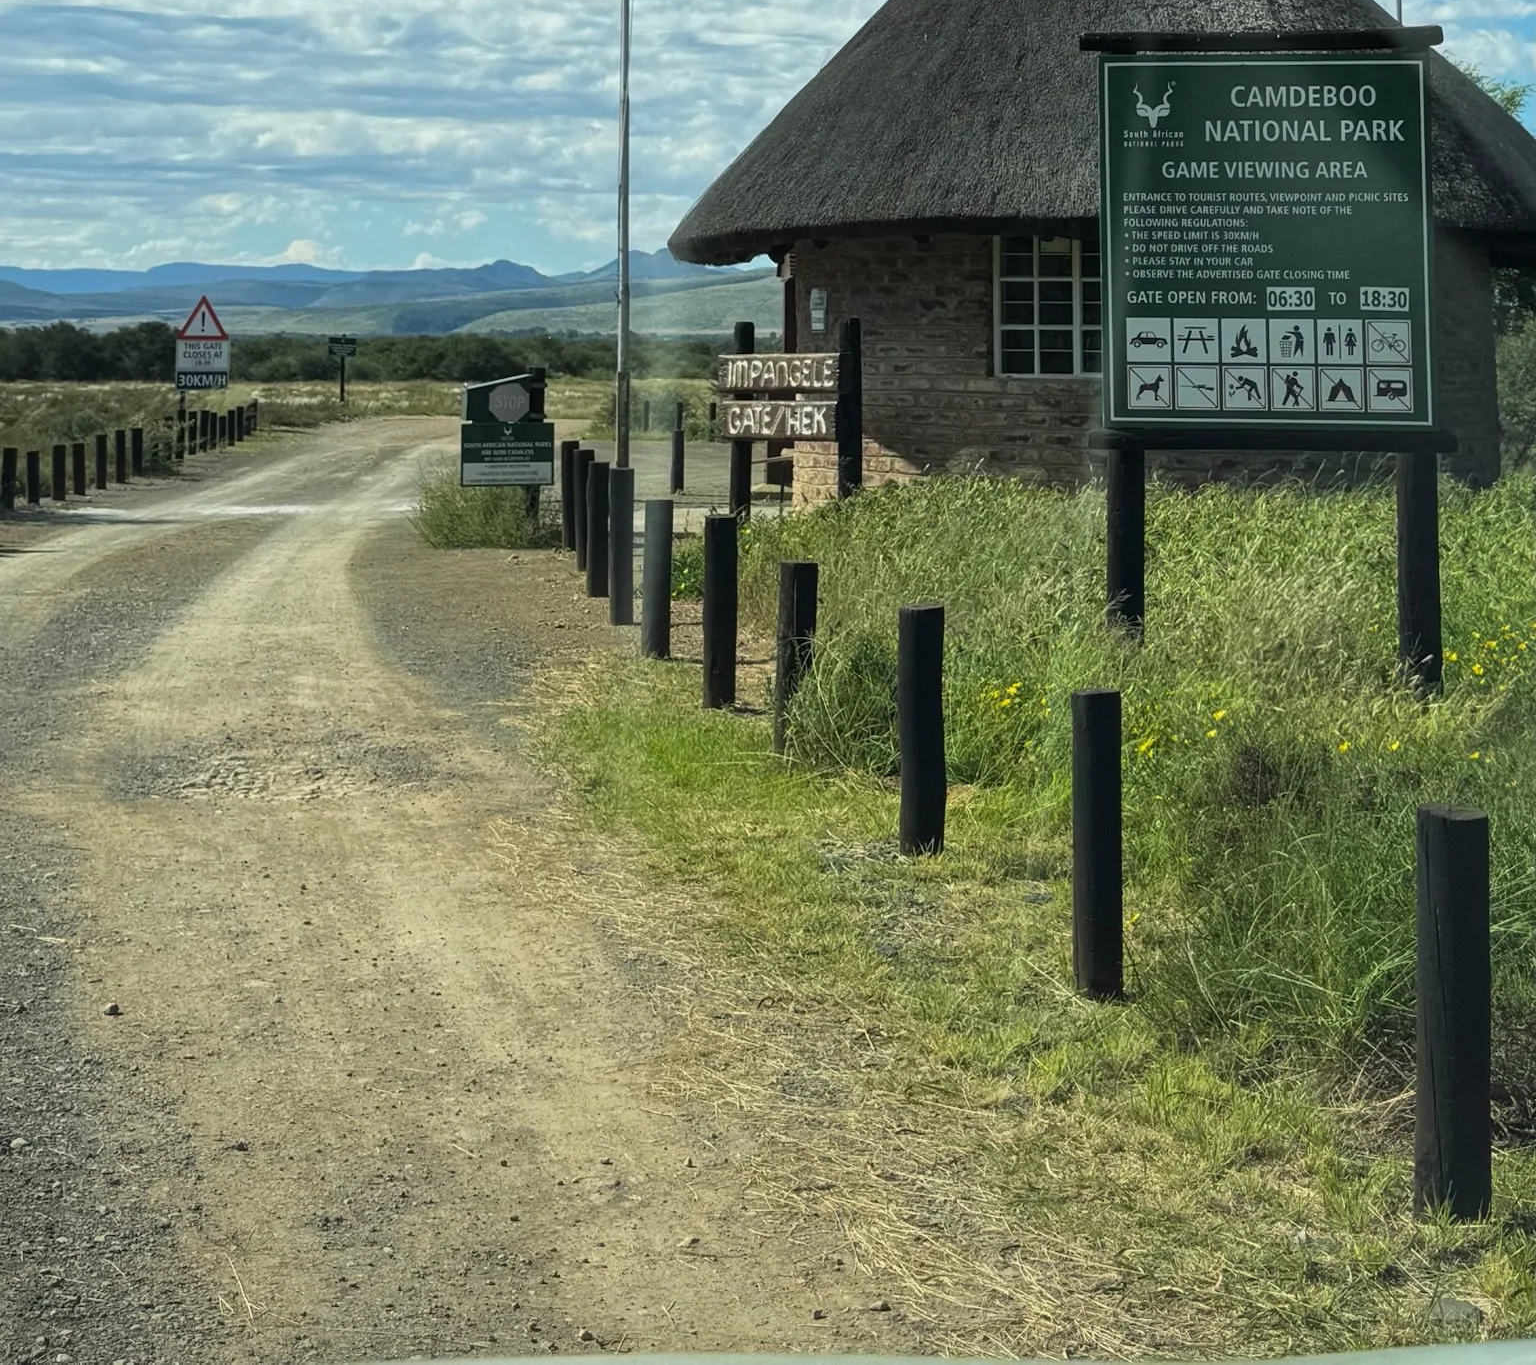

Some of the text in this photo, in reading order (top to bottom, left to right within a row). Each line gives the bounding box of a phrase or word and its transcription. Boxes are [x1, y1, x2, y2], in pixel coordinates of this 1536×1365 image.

[1230, 85, 1377, 107] CAMDEBOO
[1123, 130, 1184, 138] South African
[1205, 120, 1405, 142] NATIONAL PARK
[1162, 161, 1367, 178] GAME VIEWING AREA
[1123, 193, 1408, 203] ENTRANCE TO TOURIST ROUTES, VIEWPOINT AND PICNIC SITES
[1124, 206, 1352, 215] PLEASE DRIVE CAREFULLY AND TAKE NOTE OF THE
[1124, 219, 1248, 227] FOLLOWING REGULATIONS:
[1132, 231, 1259, 240] THE SPEED LIMIT IS 30KM/H
[1133, 244, 1273, 253] DO NOT DRIVE OFF THE ROADS
[1133, 257, 1253, 266] PLEASE STAY IN YOUR CAR
[1133, 270, 1350, 279] OBSERVE THE ADVERTISED GATE CLOSING TIME
[1127, 290, 1407, 308] GATE OPEN FROM: 06:30 TO 18:30
[183, 351, 212, 359] CLOSES
[726, 359, 834, 387] IMPANGELE
[179, 375, 226, 387] 30KM/H
[495, 395, 526, 409] STOP
[728, 406, 826, 435] GATE/HEK
